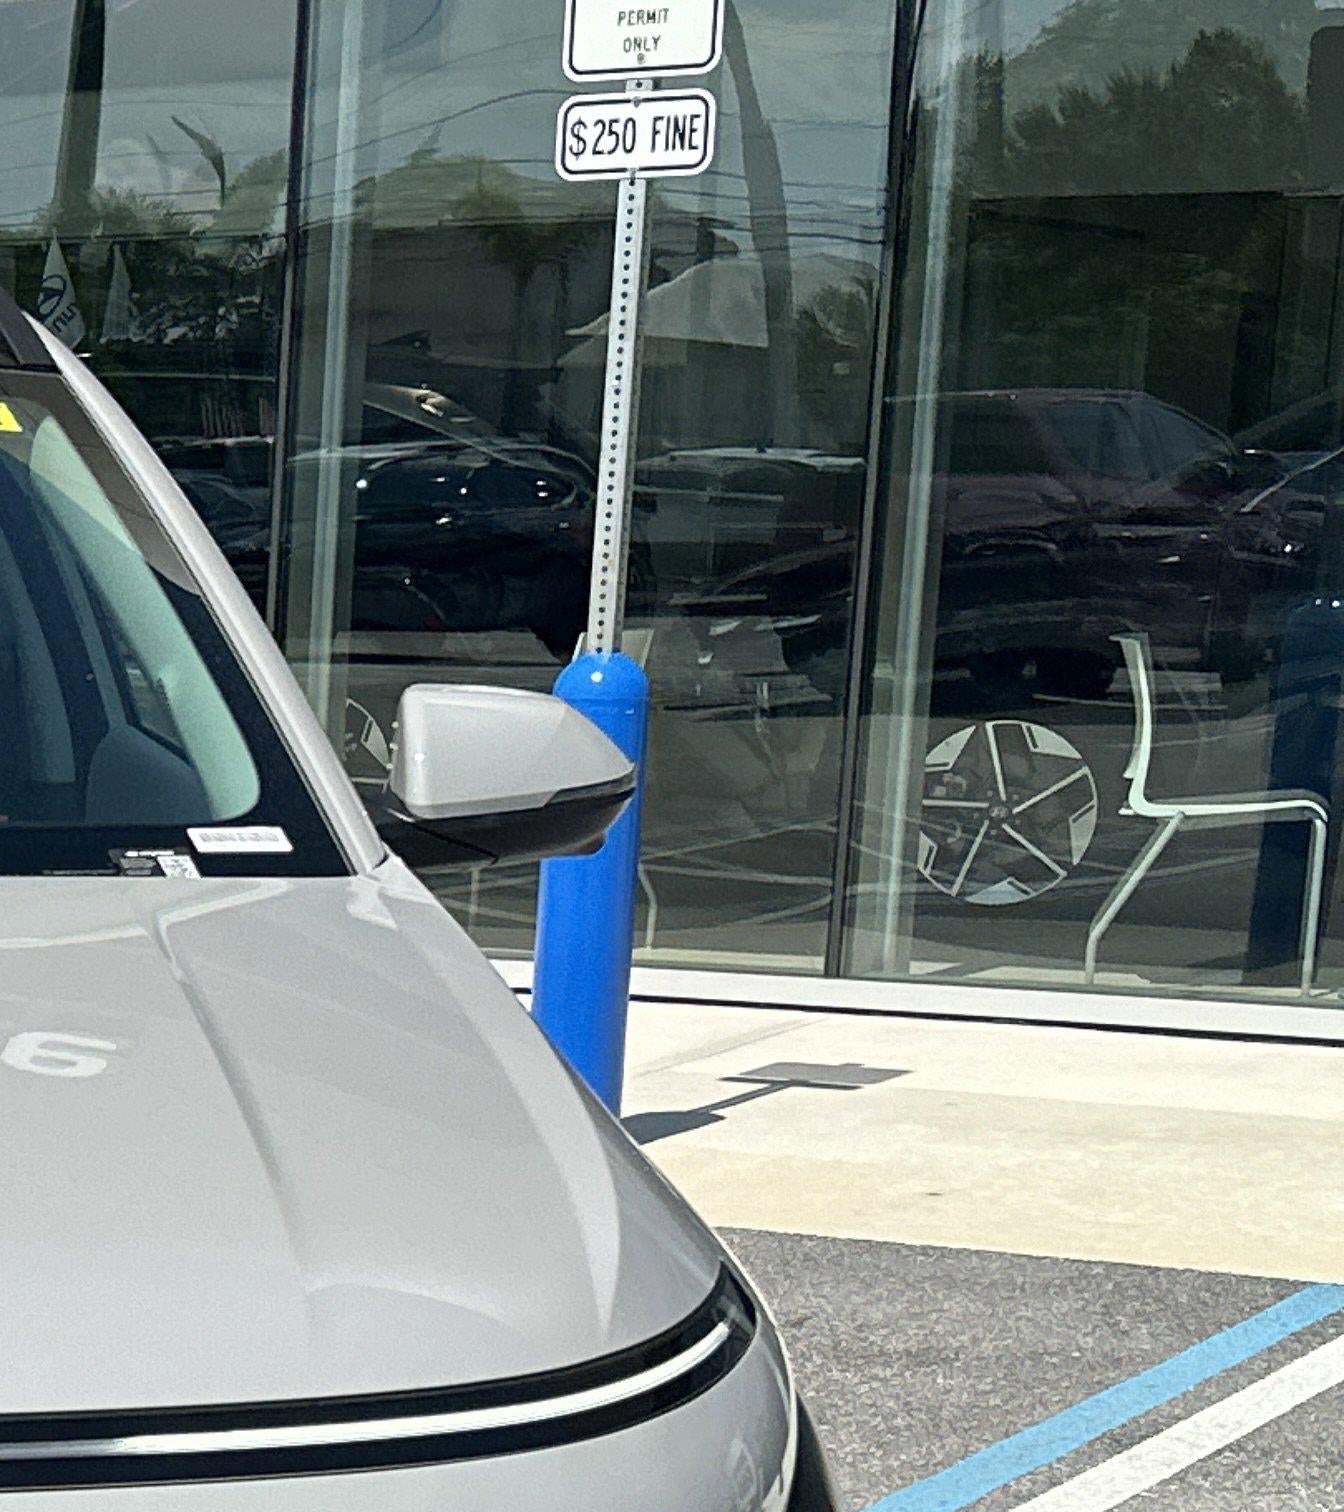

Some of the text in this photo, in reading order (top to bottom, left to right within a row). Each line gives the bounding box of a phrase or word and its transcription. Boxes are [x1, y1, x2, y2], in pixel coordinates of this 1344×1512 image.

[617, 8, 670, 27] PERMIT
[623, 35, 661, 53] ONLY
[569, 114, 702, 160] $250 FINE
